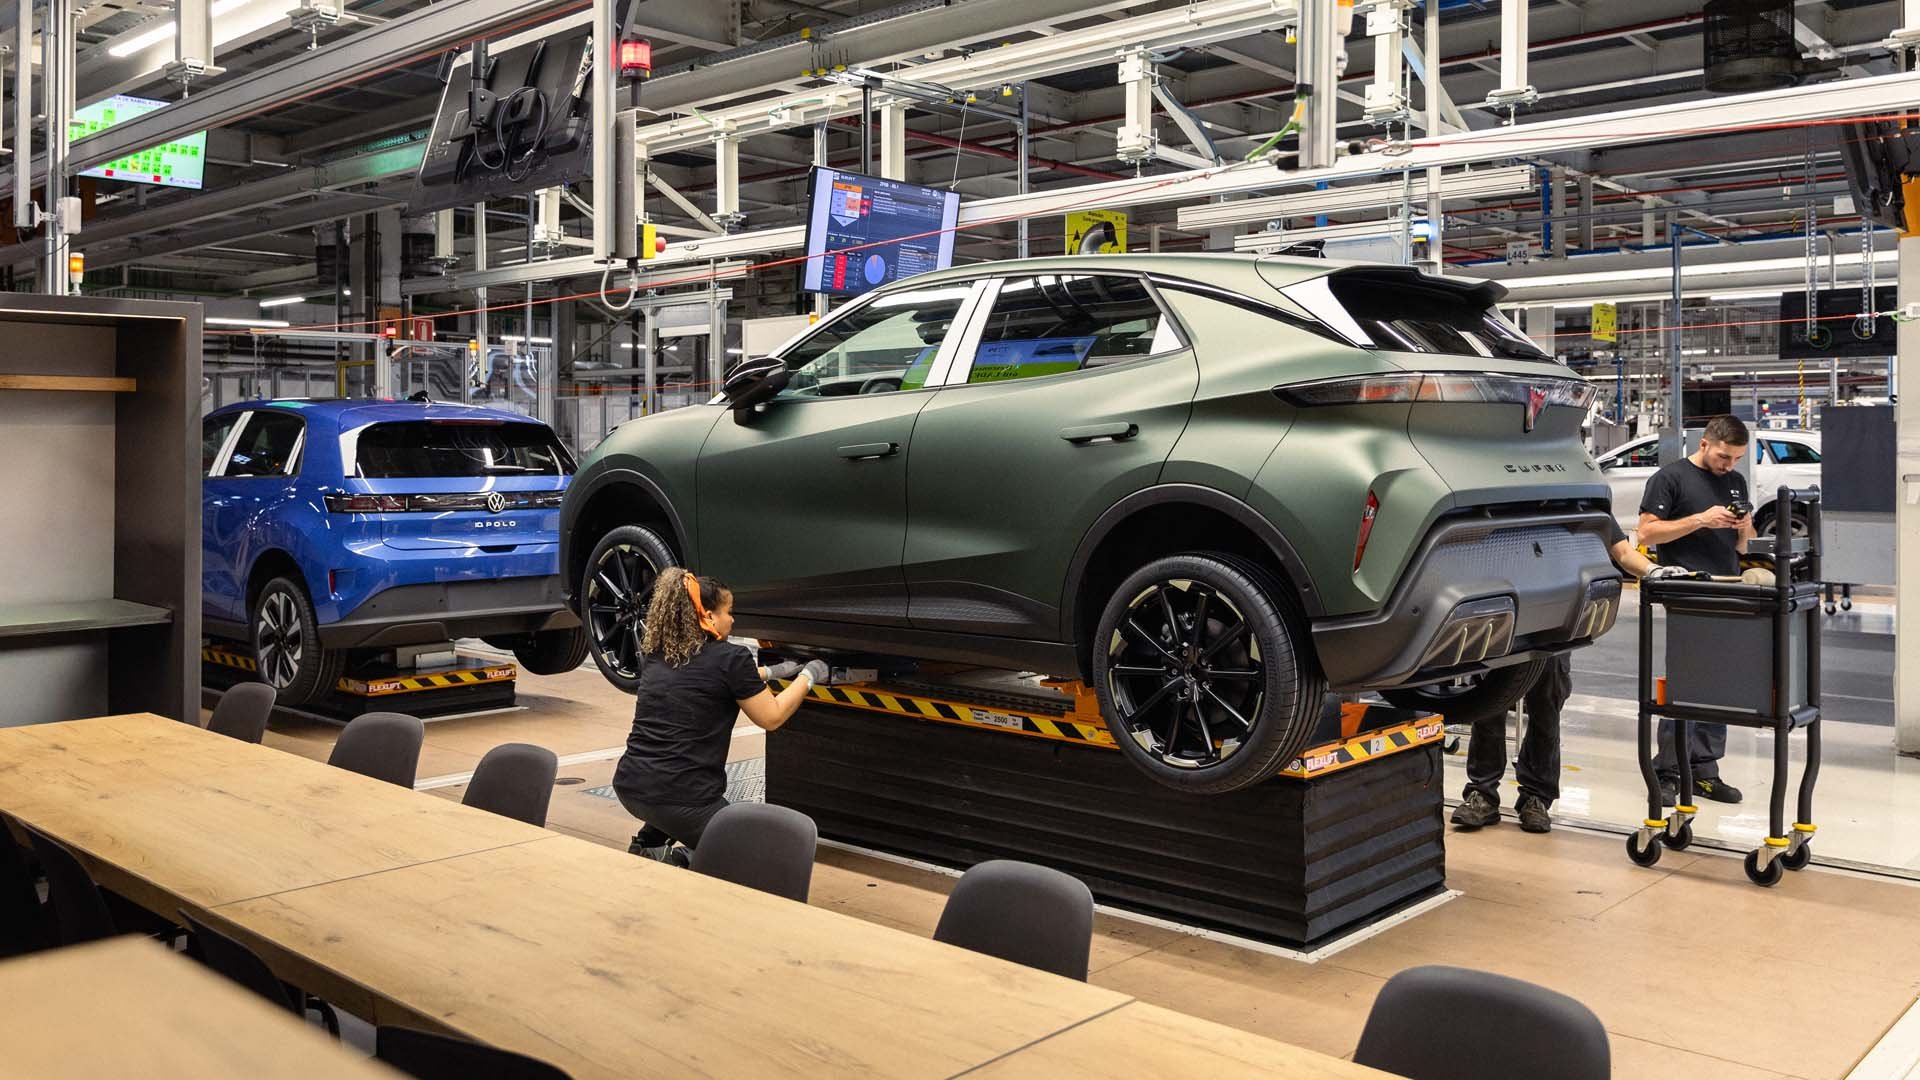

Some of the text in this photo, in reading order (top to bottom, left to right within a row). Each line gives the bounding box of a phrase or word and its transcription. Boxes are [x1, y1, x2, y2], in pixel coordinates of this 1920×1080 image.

[1507, 250, 1528, 260] L445
[368, 682, 400, 693] FLEXLIFT
[993, 715, 1008, 725] 2500
[1415, 723, 1443, 740] FLEXLIFT
[1374, 740, 1381, 751] 2
[1306, 751, 1338, 772] FLEXLIFT
